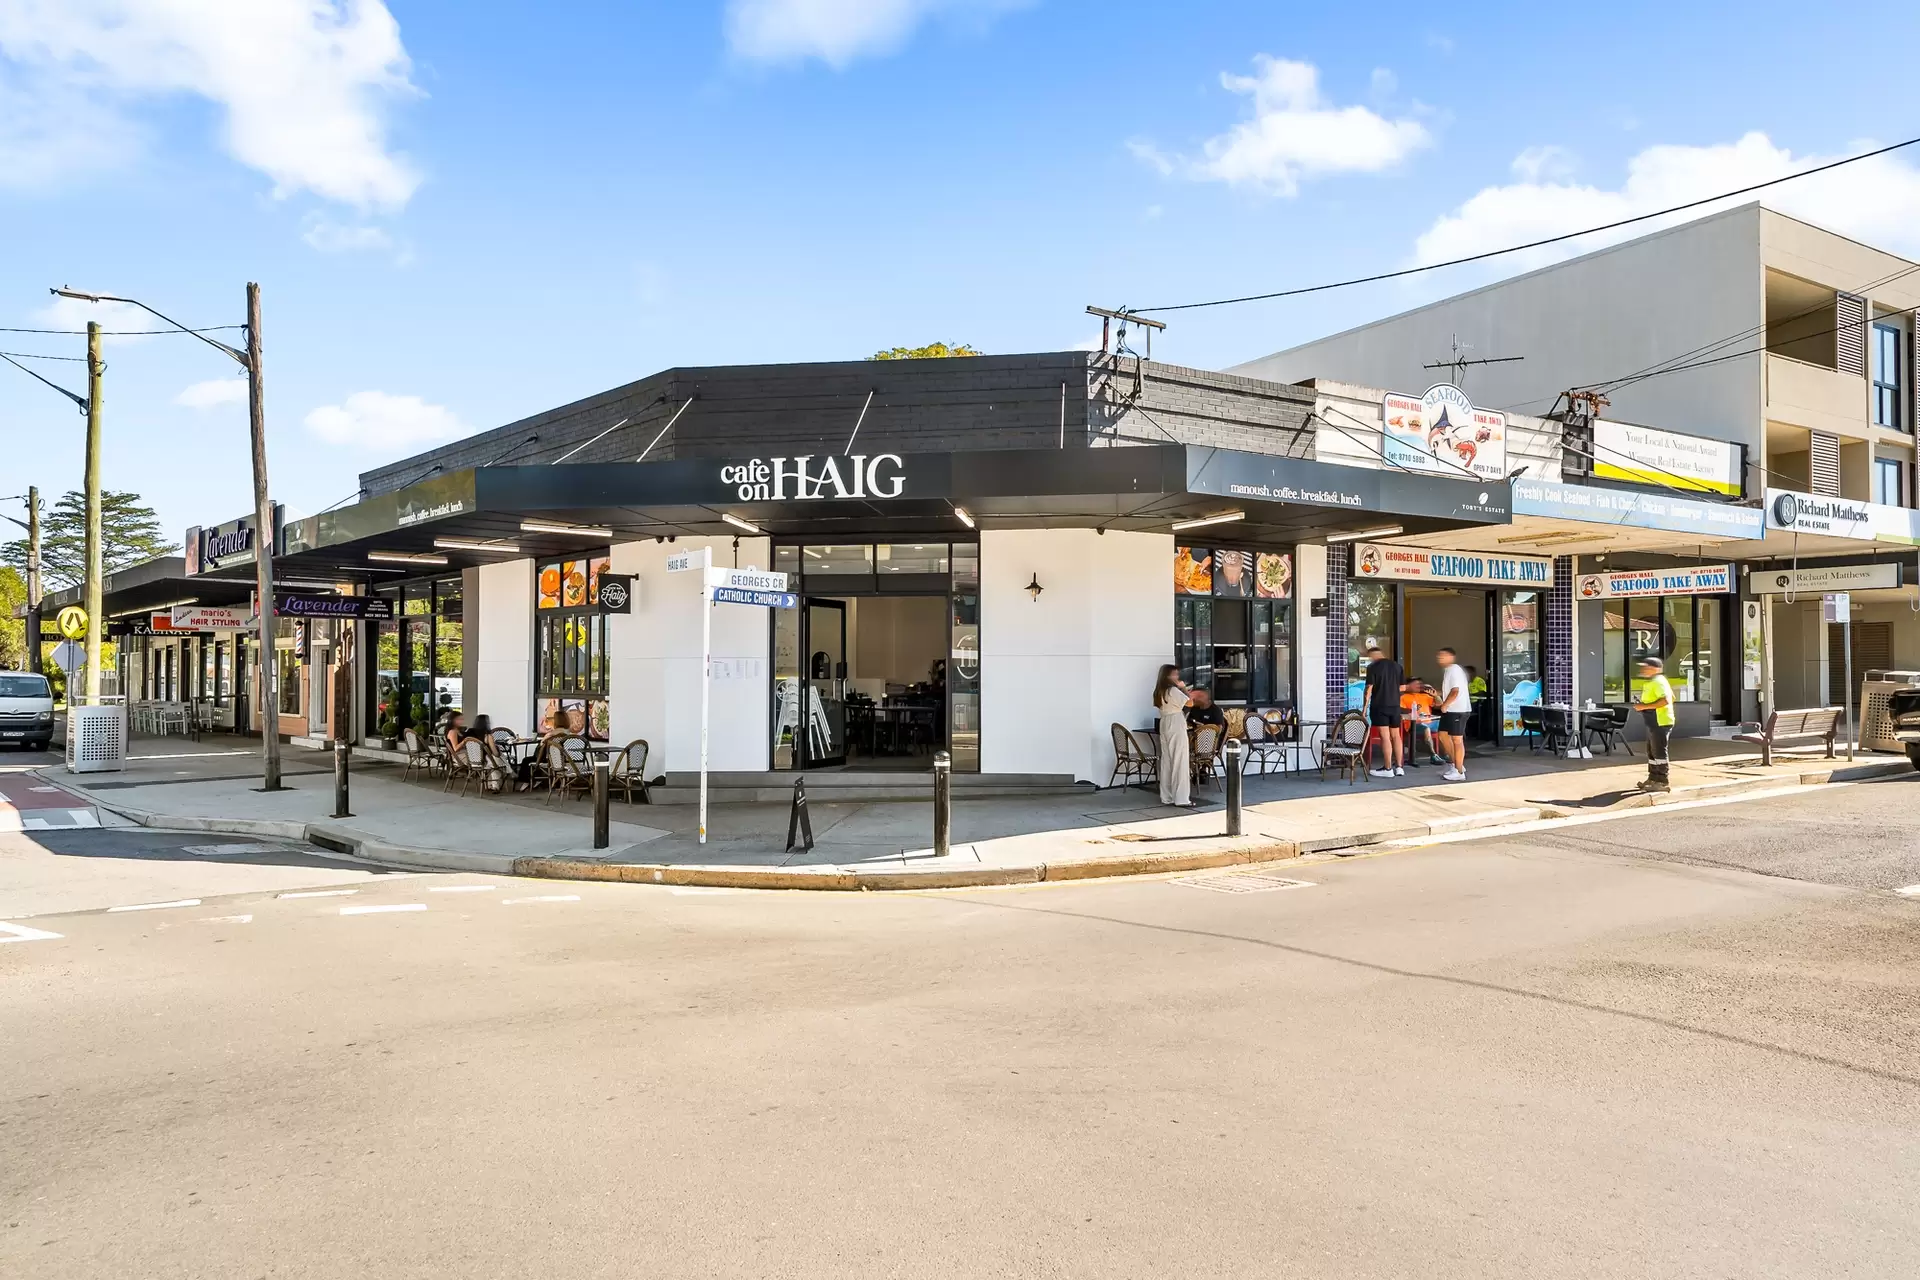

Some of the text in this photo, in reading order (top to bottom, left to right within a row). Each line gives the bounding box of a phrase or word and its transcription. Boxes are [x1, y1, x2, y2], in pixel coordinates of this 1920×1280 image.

[1387, 399, 1422, 412] GEORGES HALL
[1425, 388, 1470, 415] SEAFOOD
[1626, 432, 1717, 456] Your Local & National Award
[720, 458, 770, 484] cafe
[1474, 464, 1485, 472] OPEN
[1490, 466, 1501, 474] DAYS
[1672, 458, 1691, 470] Estate
[771, 454, 906, 499] HAIG
[738, 483, 770, 501] on
[1230, 484, 1361, 505] manoush. coffee. breakfast. lunch
[1516, 485, 1543, 502] Freshly
[1545, 488, 1562, 502] Cook
[1564, 490, 1590, 506] Seafood
[1596, 495, 1610, 508] Fish
[1798, 499, 1868, 523] Richard Matthews
[1812, 521, 1830, 530] ESTATE
[1385, 552, 1413, 562] GEORGES
[1415, 554, 1429, 563] HALL
[1431, 555, 1547, 581] SEAFOOD TAKE AWAY
[1796, 572, 1870, 581] Richard Matthews
[732, 575, 784, 588] GEORGES CR
[1611, 574, 1726, 591] SEAFOOD TAKE AWAY
[601, 588, 628, 604] Haig
[719, 590, 782, 605] CATHOLIC CHURCH
[281, 596, 359, 614] Lavender
